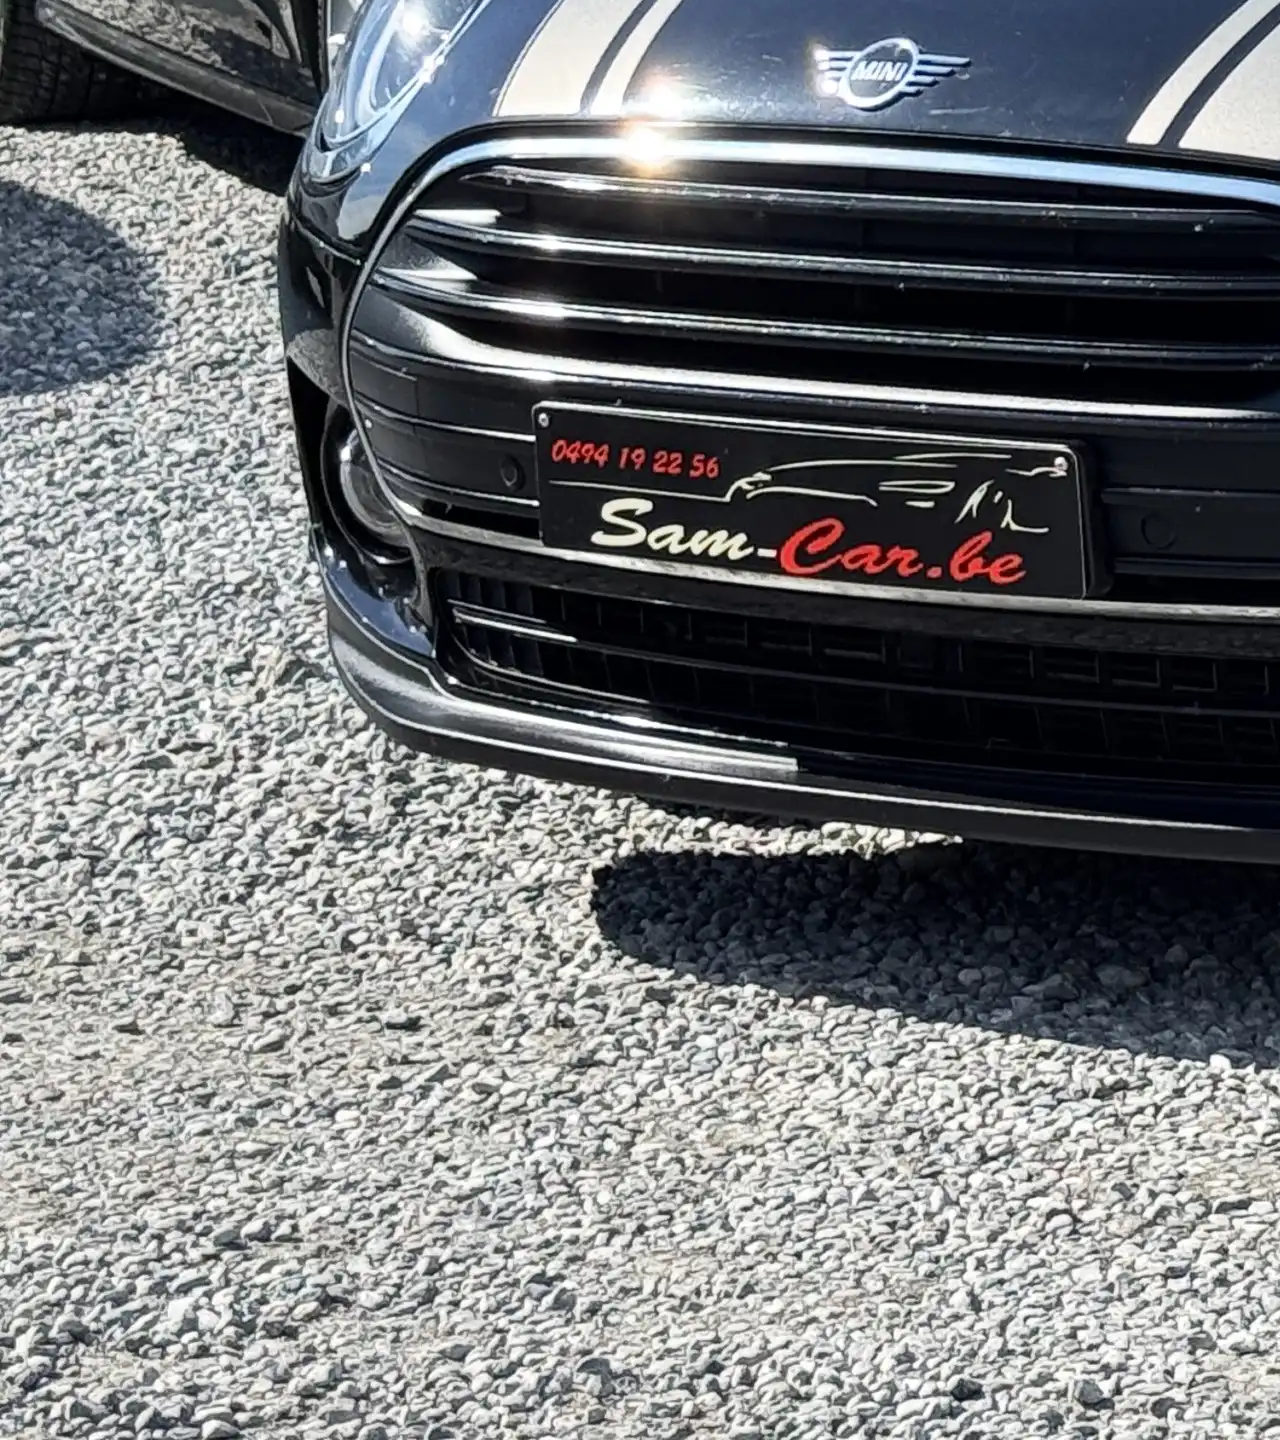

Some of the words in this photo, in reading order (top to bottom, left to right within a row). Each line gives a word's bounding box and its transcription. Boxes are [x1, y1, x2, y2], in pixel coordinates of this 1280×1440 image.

[852, 60, 909, 82] MINI
[551, 439, 610, 468] 0494
[618, 447, 647, 471] 19
[652, 450, 683, 475] 22
[689, 452, 719, 479] 56
[590, 497, 1026, 585] Sam-Car.be
